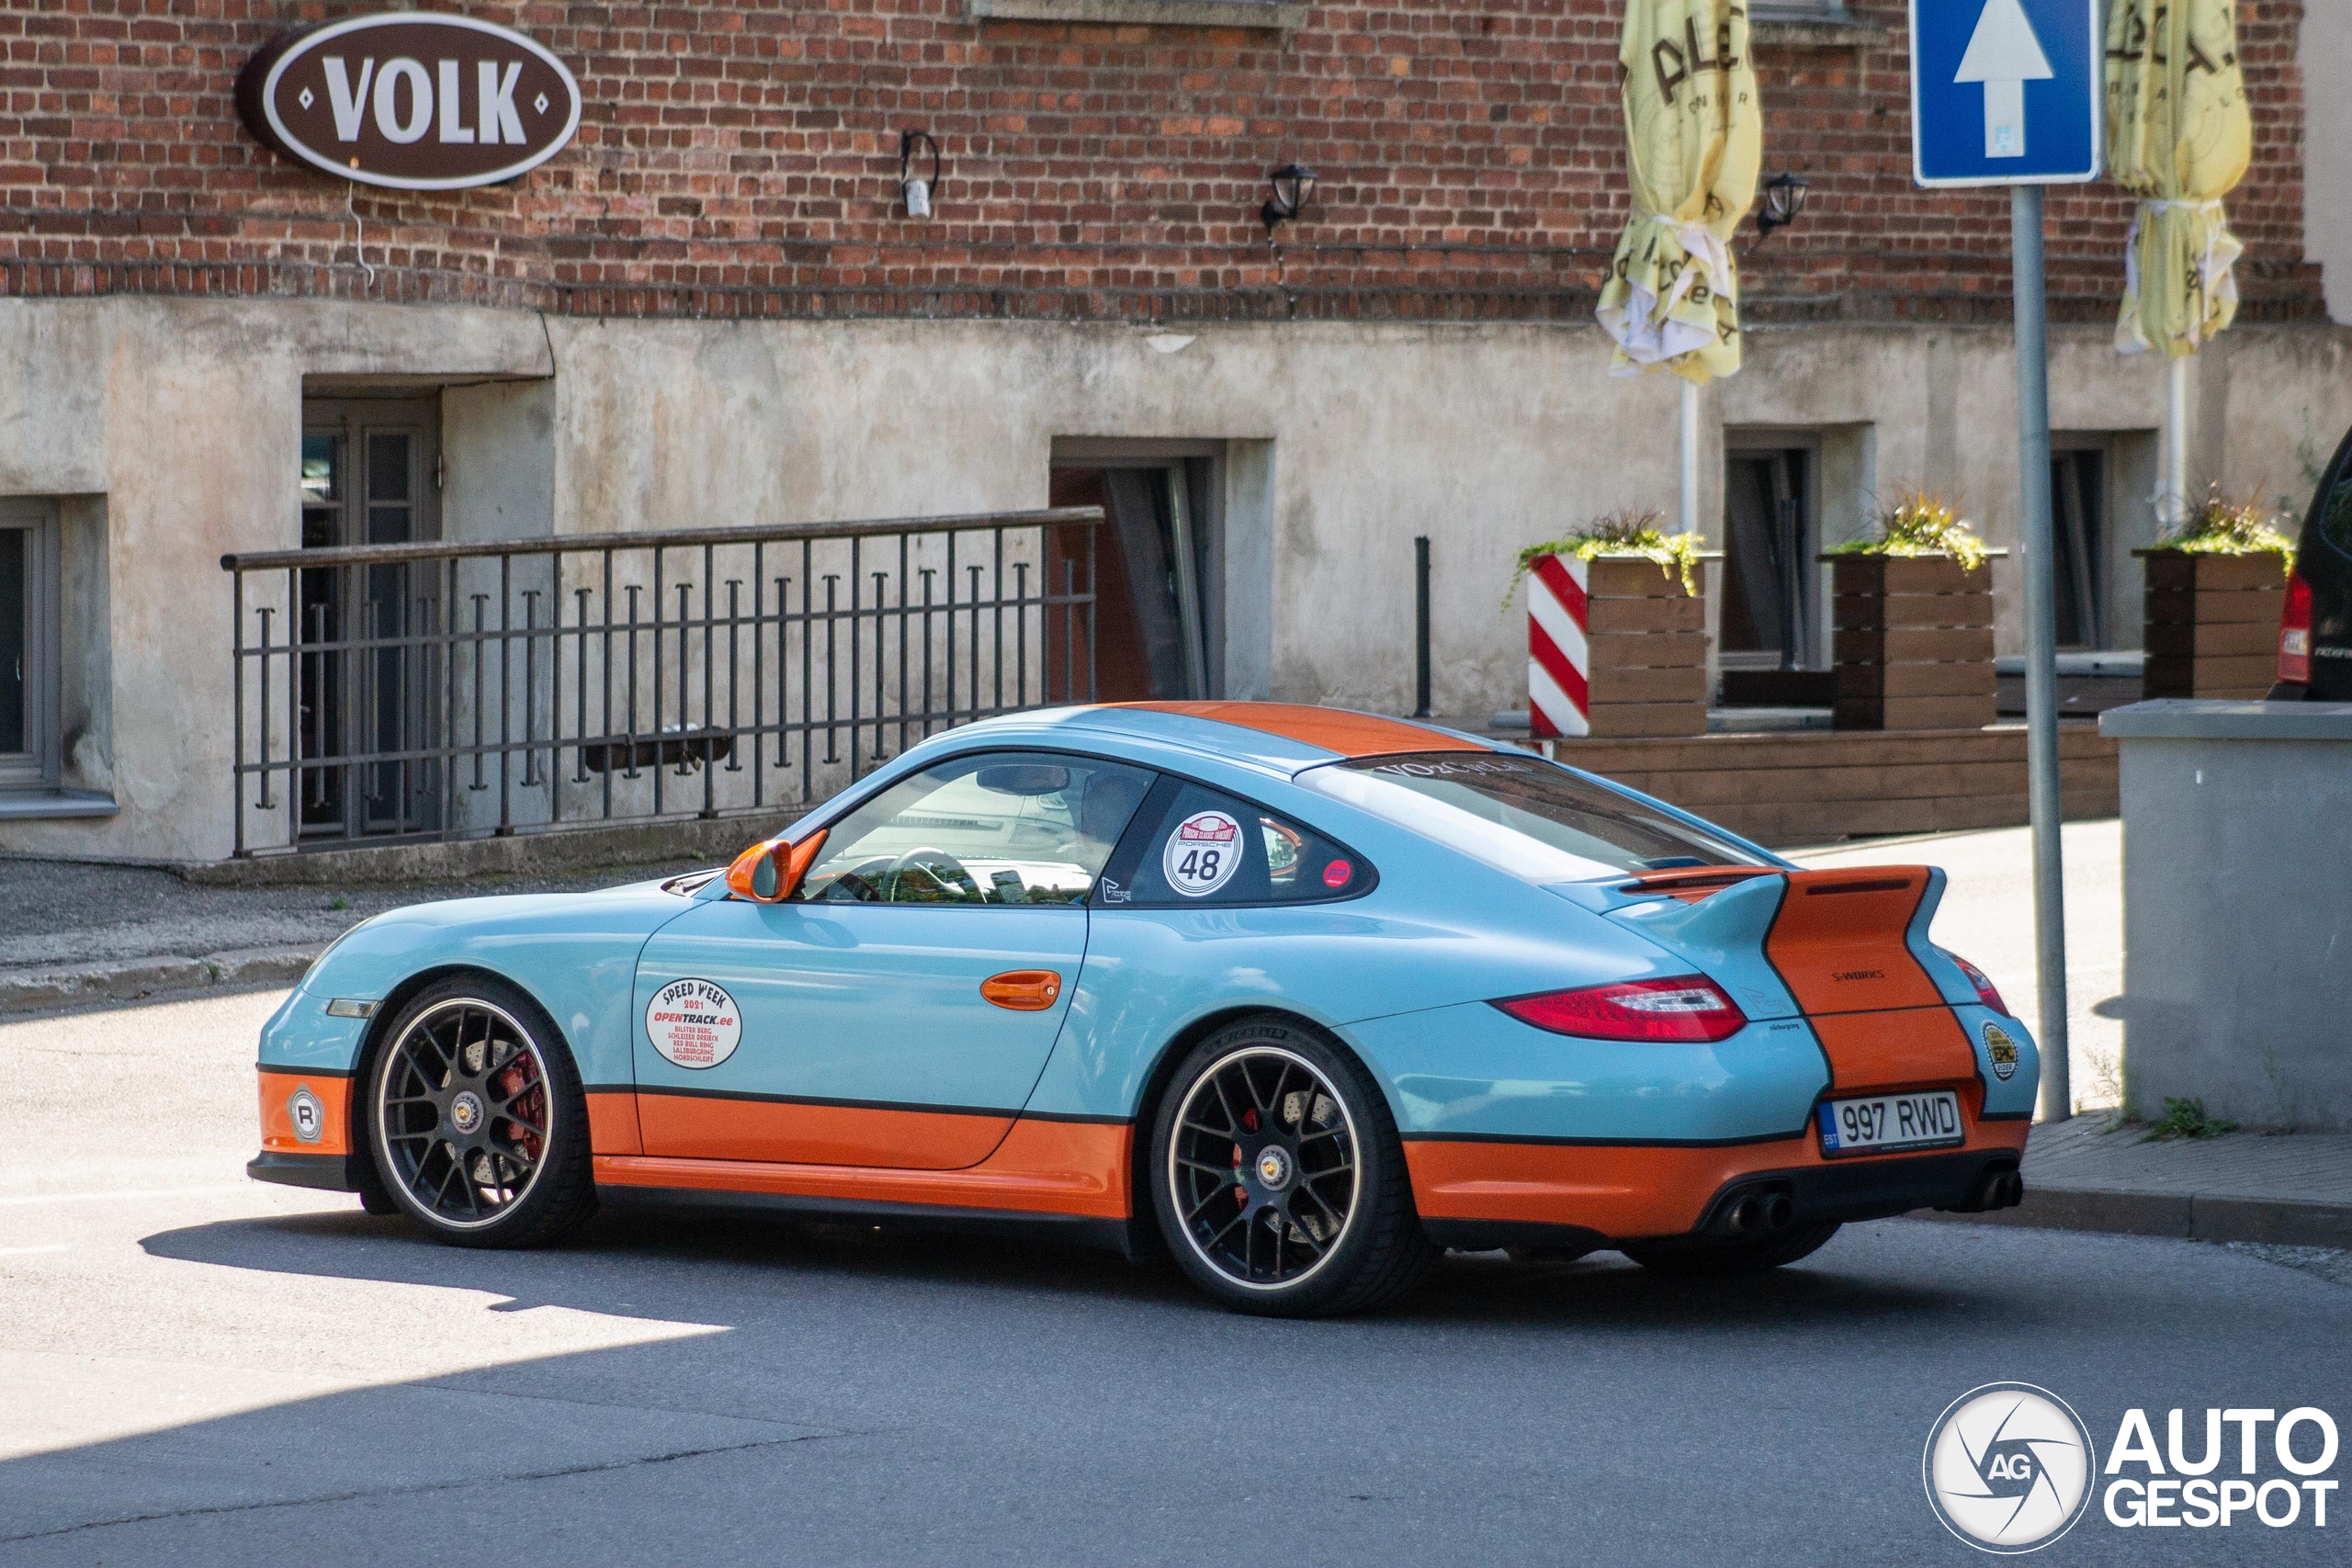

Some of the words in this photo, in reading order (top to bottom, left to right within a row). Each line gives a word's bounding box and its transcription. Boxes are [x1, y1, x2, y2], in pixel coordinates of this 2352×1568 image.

[322, 55, 527, 144] VOLK
[1178, 850, 1220, 880] 48
[1832, 969, 1885, 982] S-WORKS
[662, 982, 695, 1006] SPEED
[698, 983, 727, 1009] WEEK
[684, 999, 704, 1010] 2021
[654, 1011, 733, 1026] OPENTRACK.ee
[674, 1025, 696, 1033] BILSTER
[668, 1032, 695, 1041] SCHLEIZER
[673, 1047, 715, 1055] SALZBURGRING
[673, 1054, 714, 1063] NORDSCHLEIFE
[298, 1105, 314, 1125] R
[1842, 1101, 1885, 1142] 997
[1895, 1097, 1955, 1137] RWD
[1824, 1134, 1838, 1145] EST
